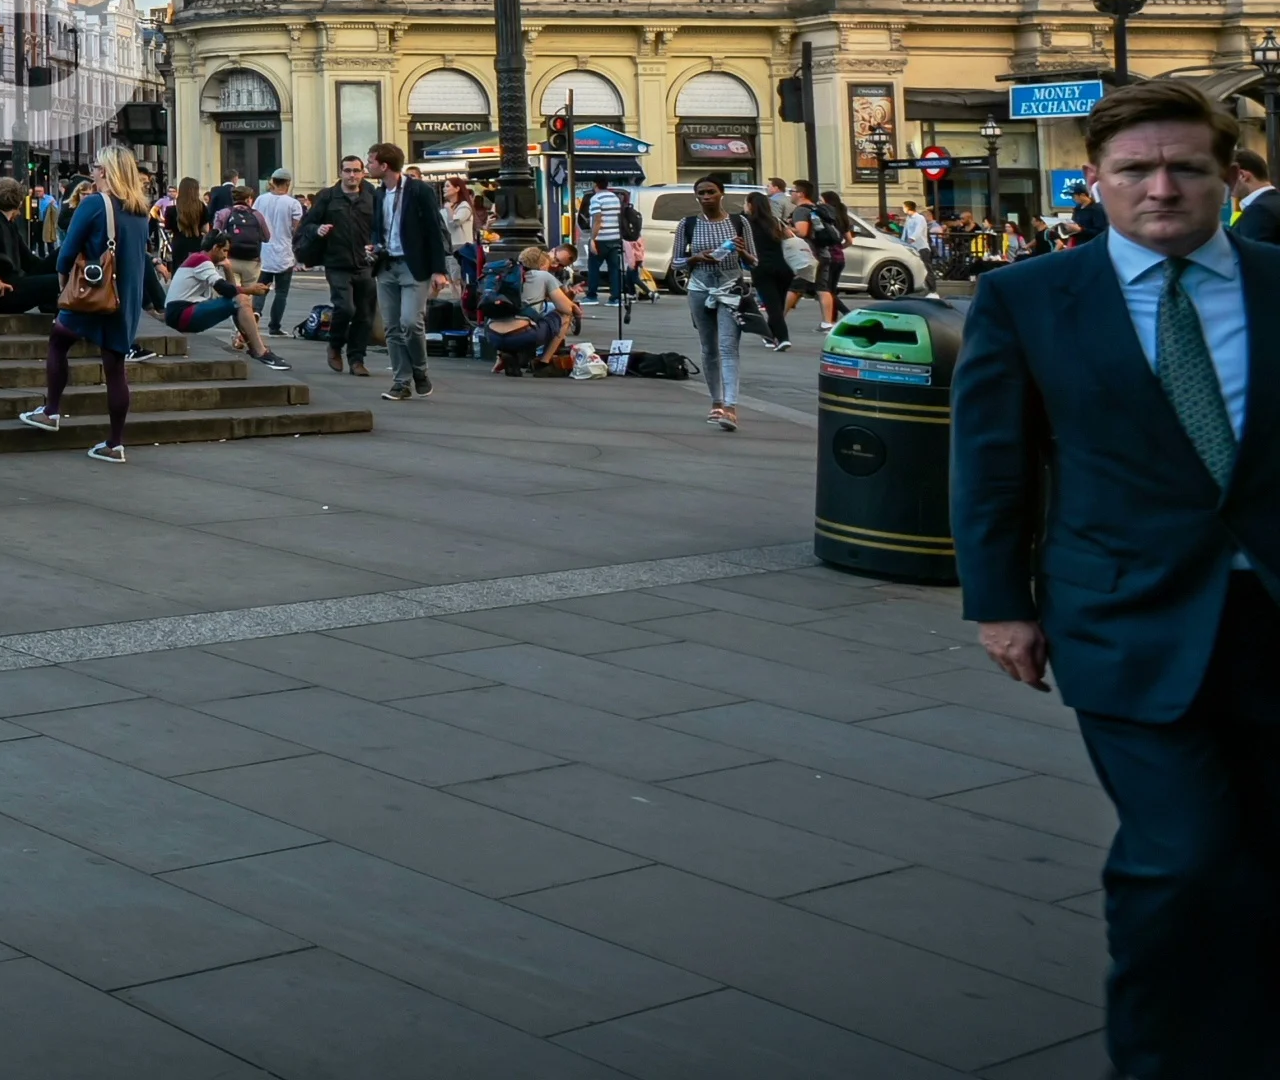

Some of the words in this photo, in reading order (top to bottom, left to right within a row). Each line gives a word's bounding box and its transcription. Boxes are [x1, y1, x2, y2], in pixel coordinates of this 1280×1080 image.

[1032, 86, 1083, 100] MONEY
[220, 120, 275, 129] ATTRACTION
[415, 122, 482, 131] ATTRACTION
[681, 125, 750, 134] ATTRACTION
[915, 159, 950, 167] UNDERGROUND
